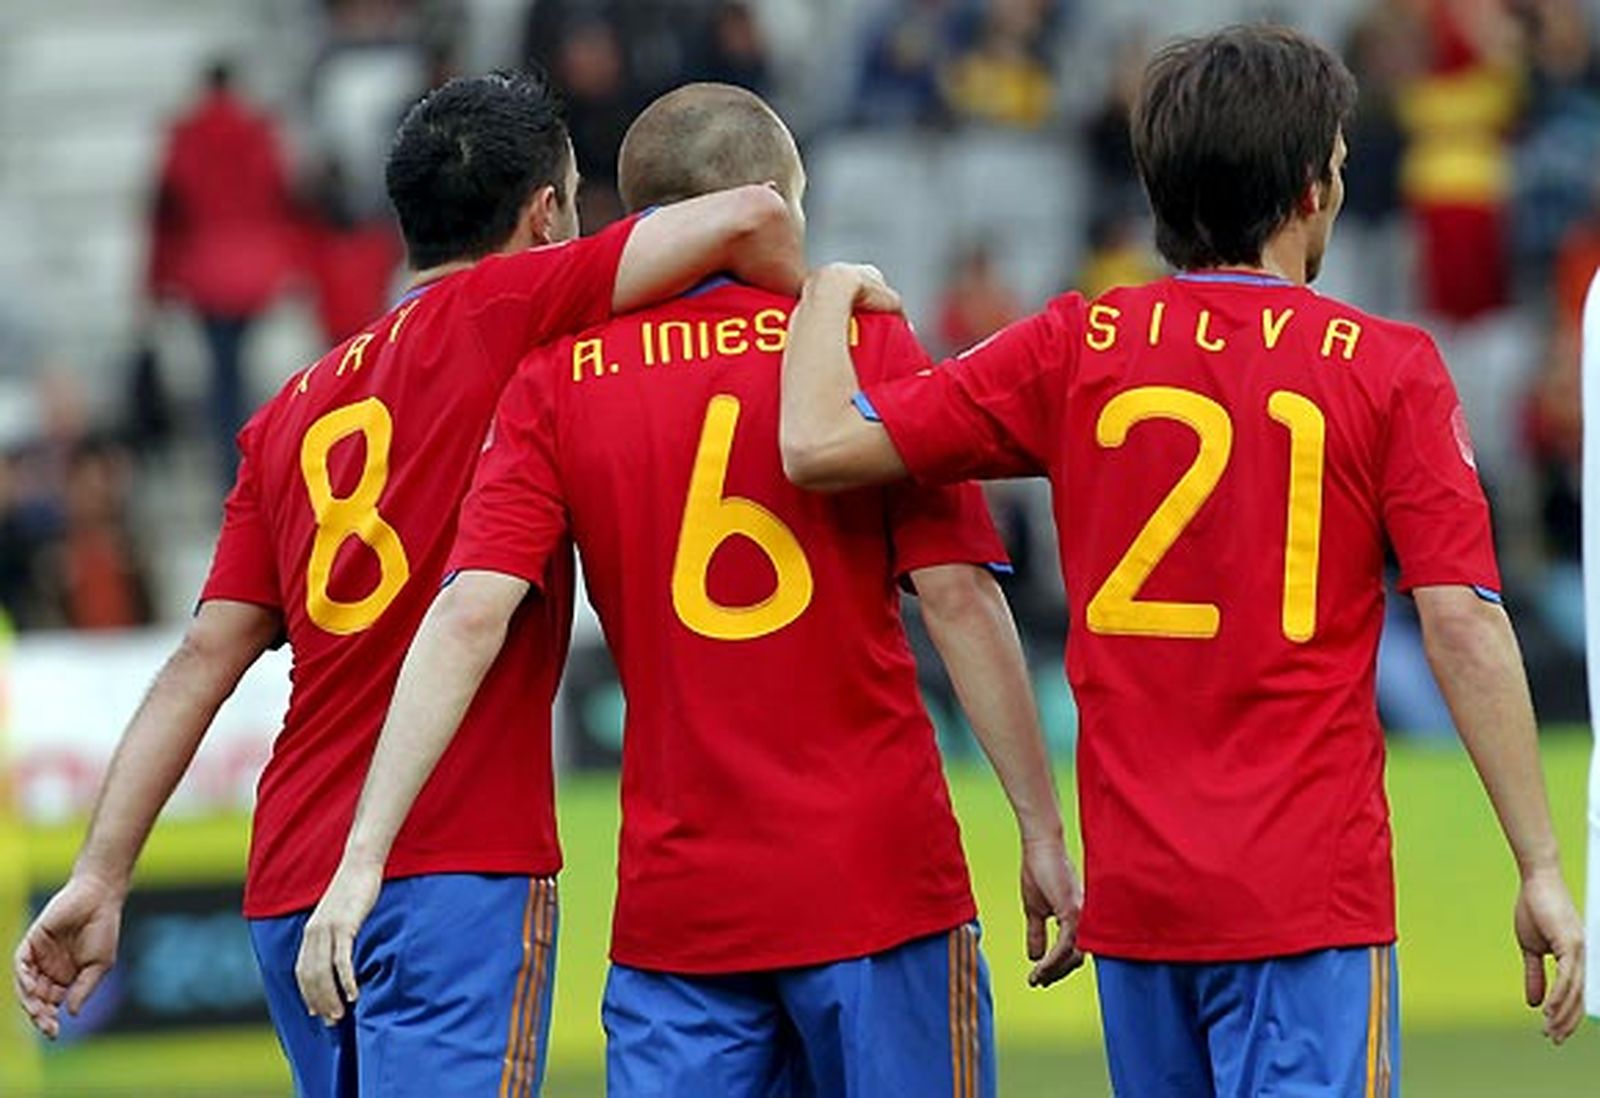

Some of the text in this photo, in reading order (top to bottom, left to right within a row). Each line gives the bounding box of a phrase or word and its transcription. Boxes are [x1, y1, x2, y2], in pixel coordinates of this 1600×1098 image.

[572, 307, 861, 382] A. INIES
[1085, 301, 1363, 361] SILVA
[299, 396, 411, 637] 8
[671, 394, 815, 641] 6
[1085, 385, 1327, 644] 21
